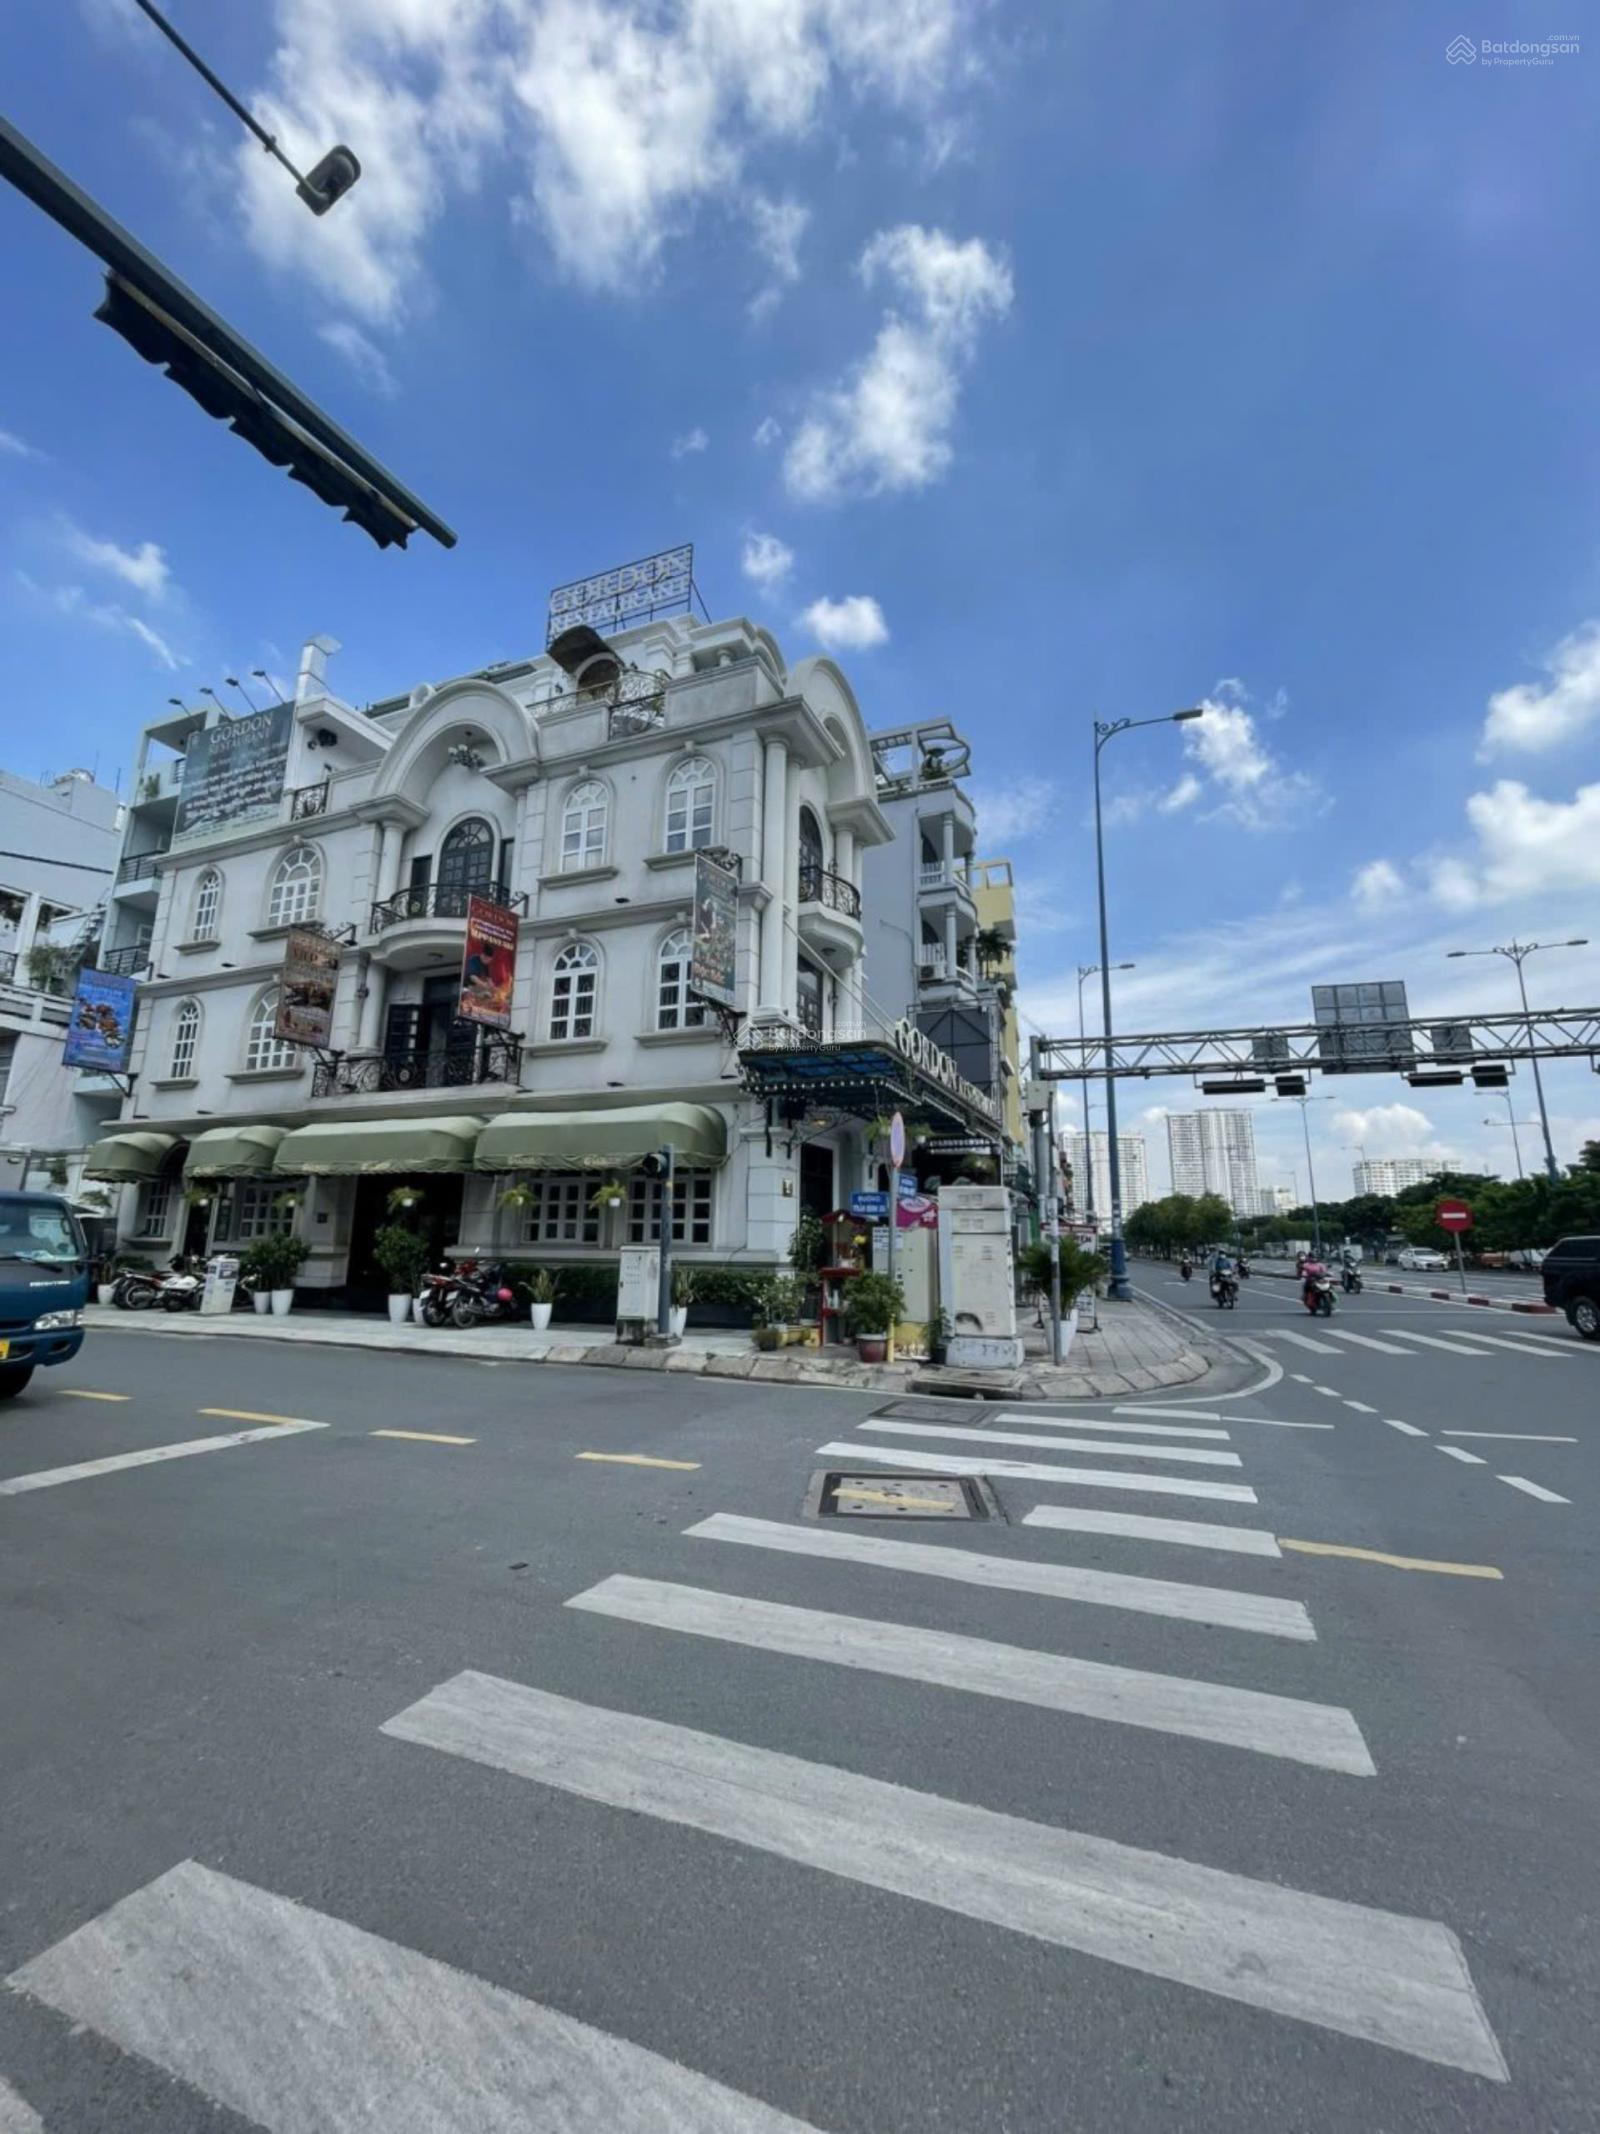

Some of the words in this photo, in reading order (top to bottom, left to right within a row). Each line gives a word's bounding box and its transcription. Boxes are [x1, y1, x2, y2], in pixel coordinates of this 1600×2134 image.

[550, 548, 691, 615] GORDON
[210, 711, 273, 744] GORDON
[895, 1017, 958, 1092] GORDON
